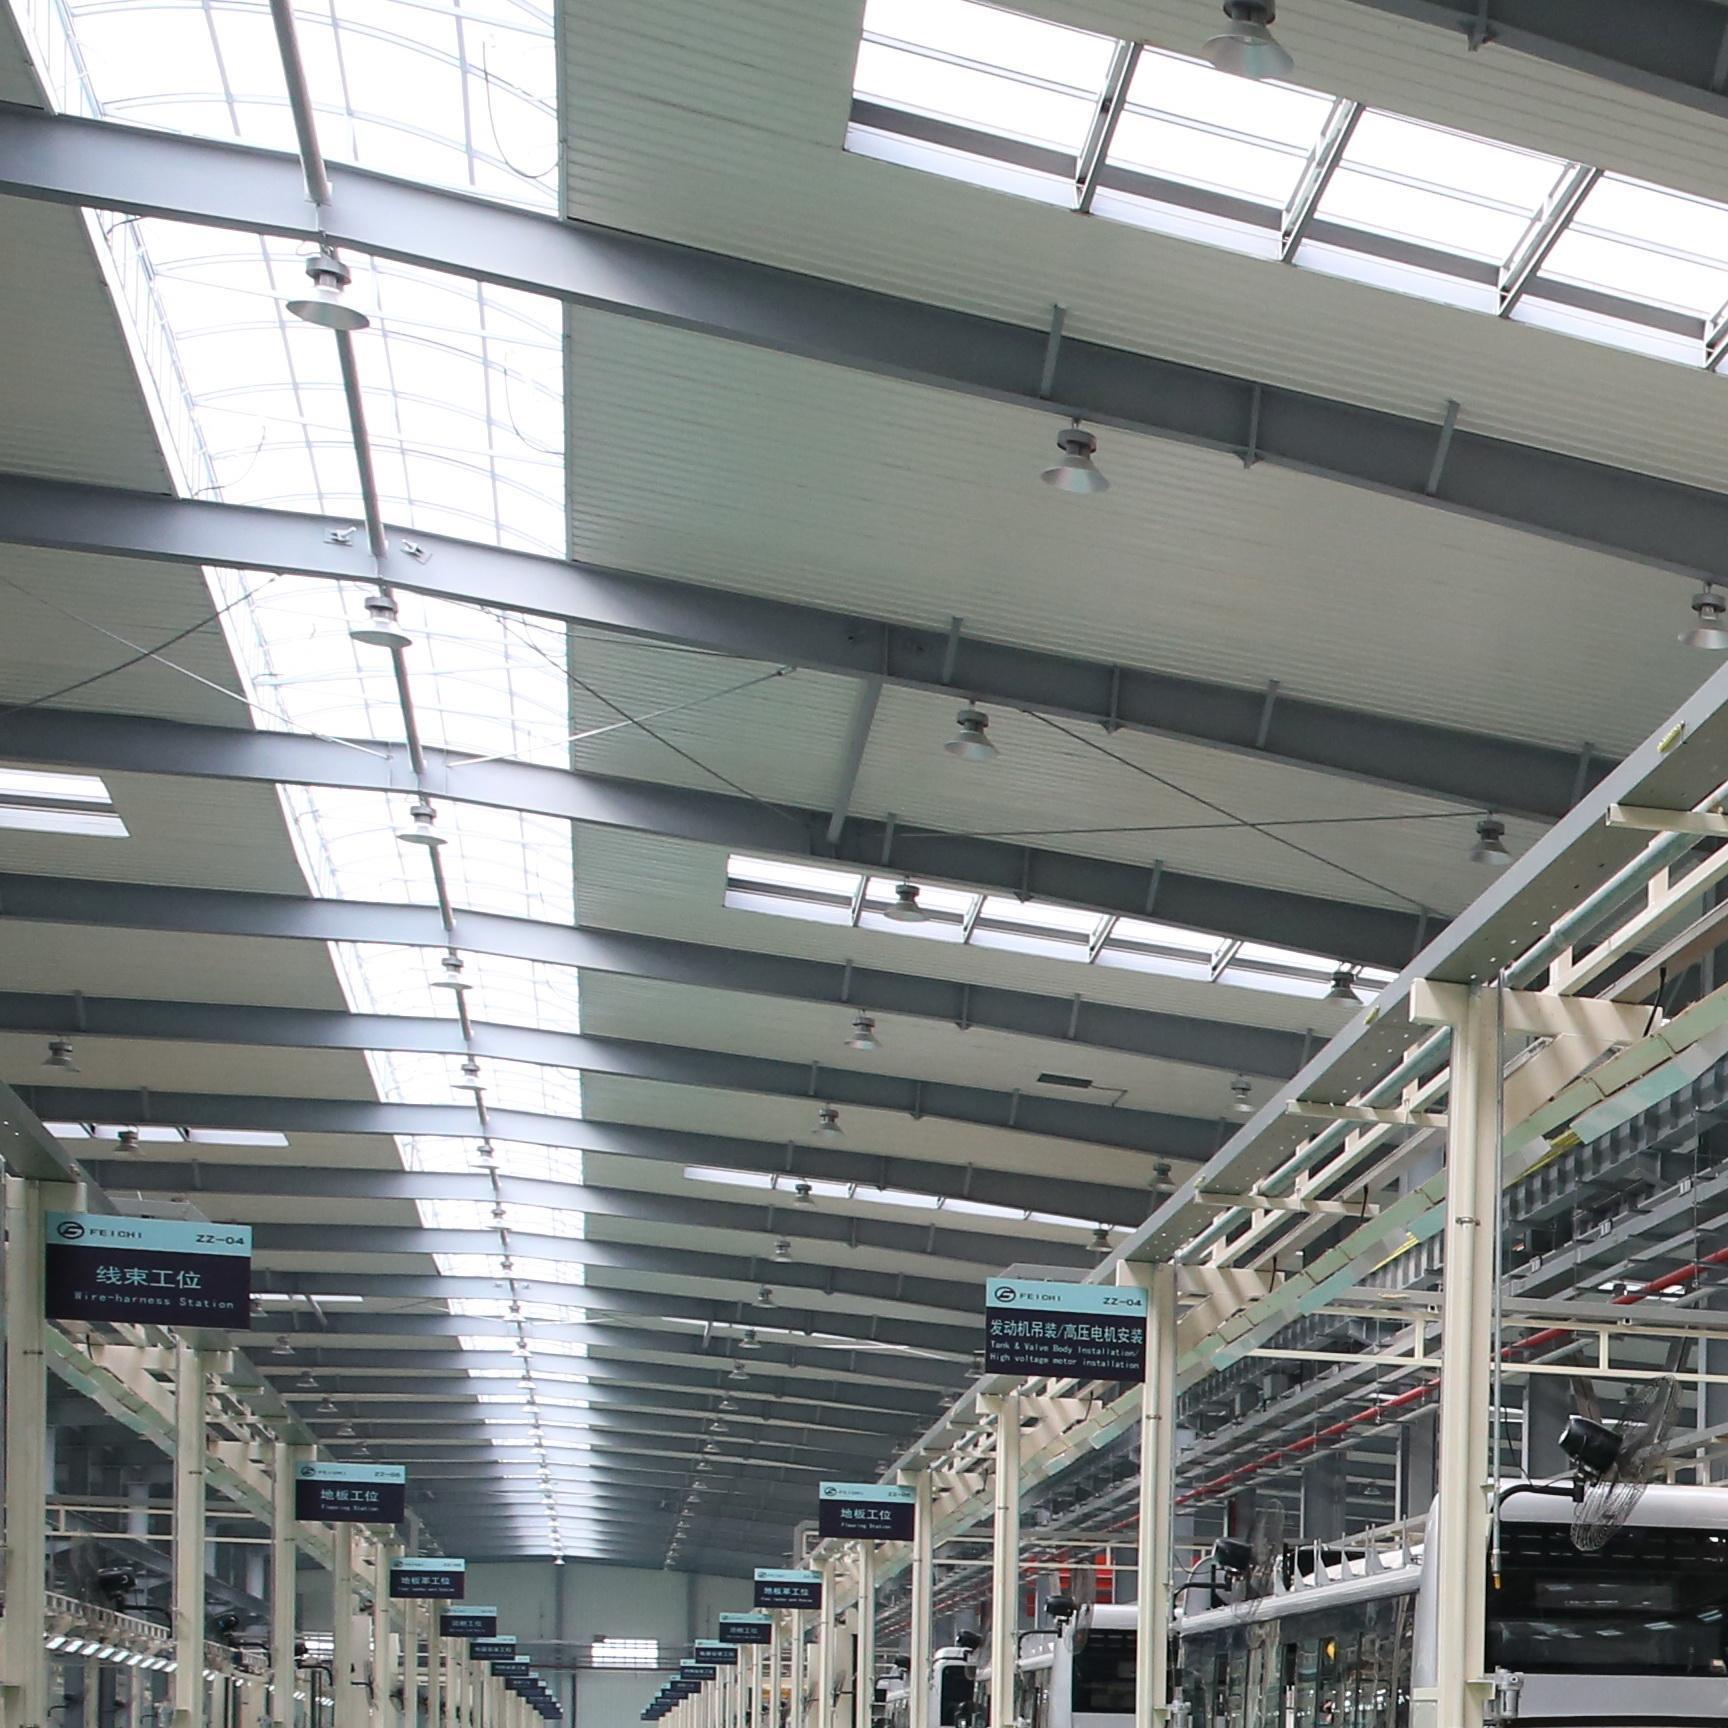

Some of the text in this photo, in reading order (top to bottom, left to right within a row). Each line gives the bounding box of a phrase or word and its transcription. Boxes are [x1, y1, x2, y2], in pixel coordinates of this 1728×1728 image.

[89, 1228, 142, 1239] FEICHI
[196, 1234, 245, 1245] ZZ-04
[96, 1266, 202, 1289] 线束工位
[74, 1291, 234, 1309] Wire-harness Station
[1019, 1293, 1062, 1302] FEICHI
[1103, 1297, 1142, 1307] ZZ-04
[990, 1319, 1143, 1345] 发动机吊装/高压电机安装
[990, 1353, 1010, 1363] High
